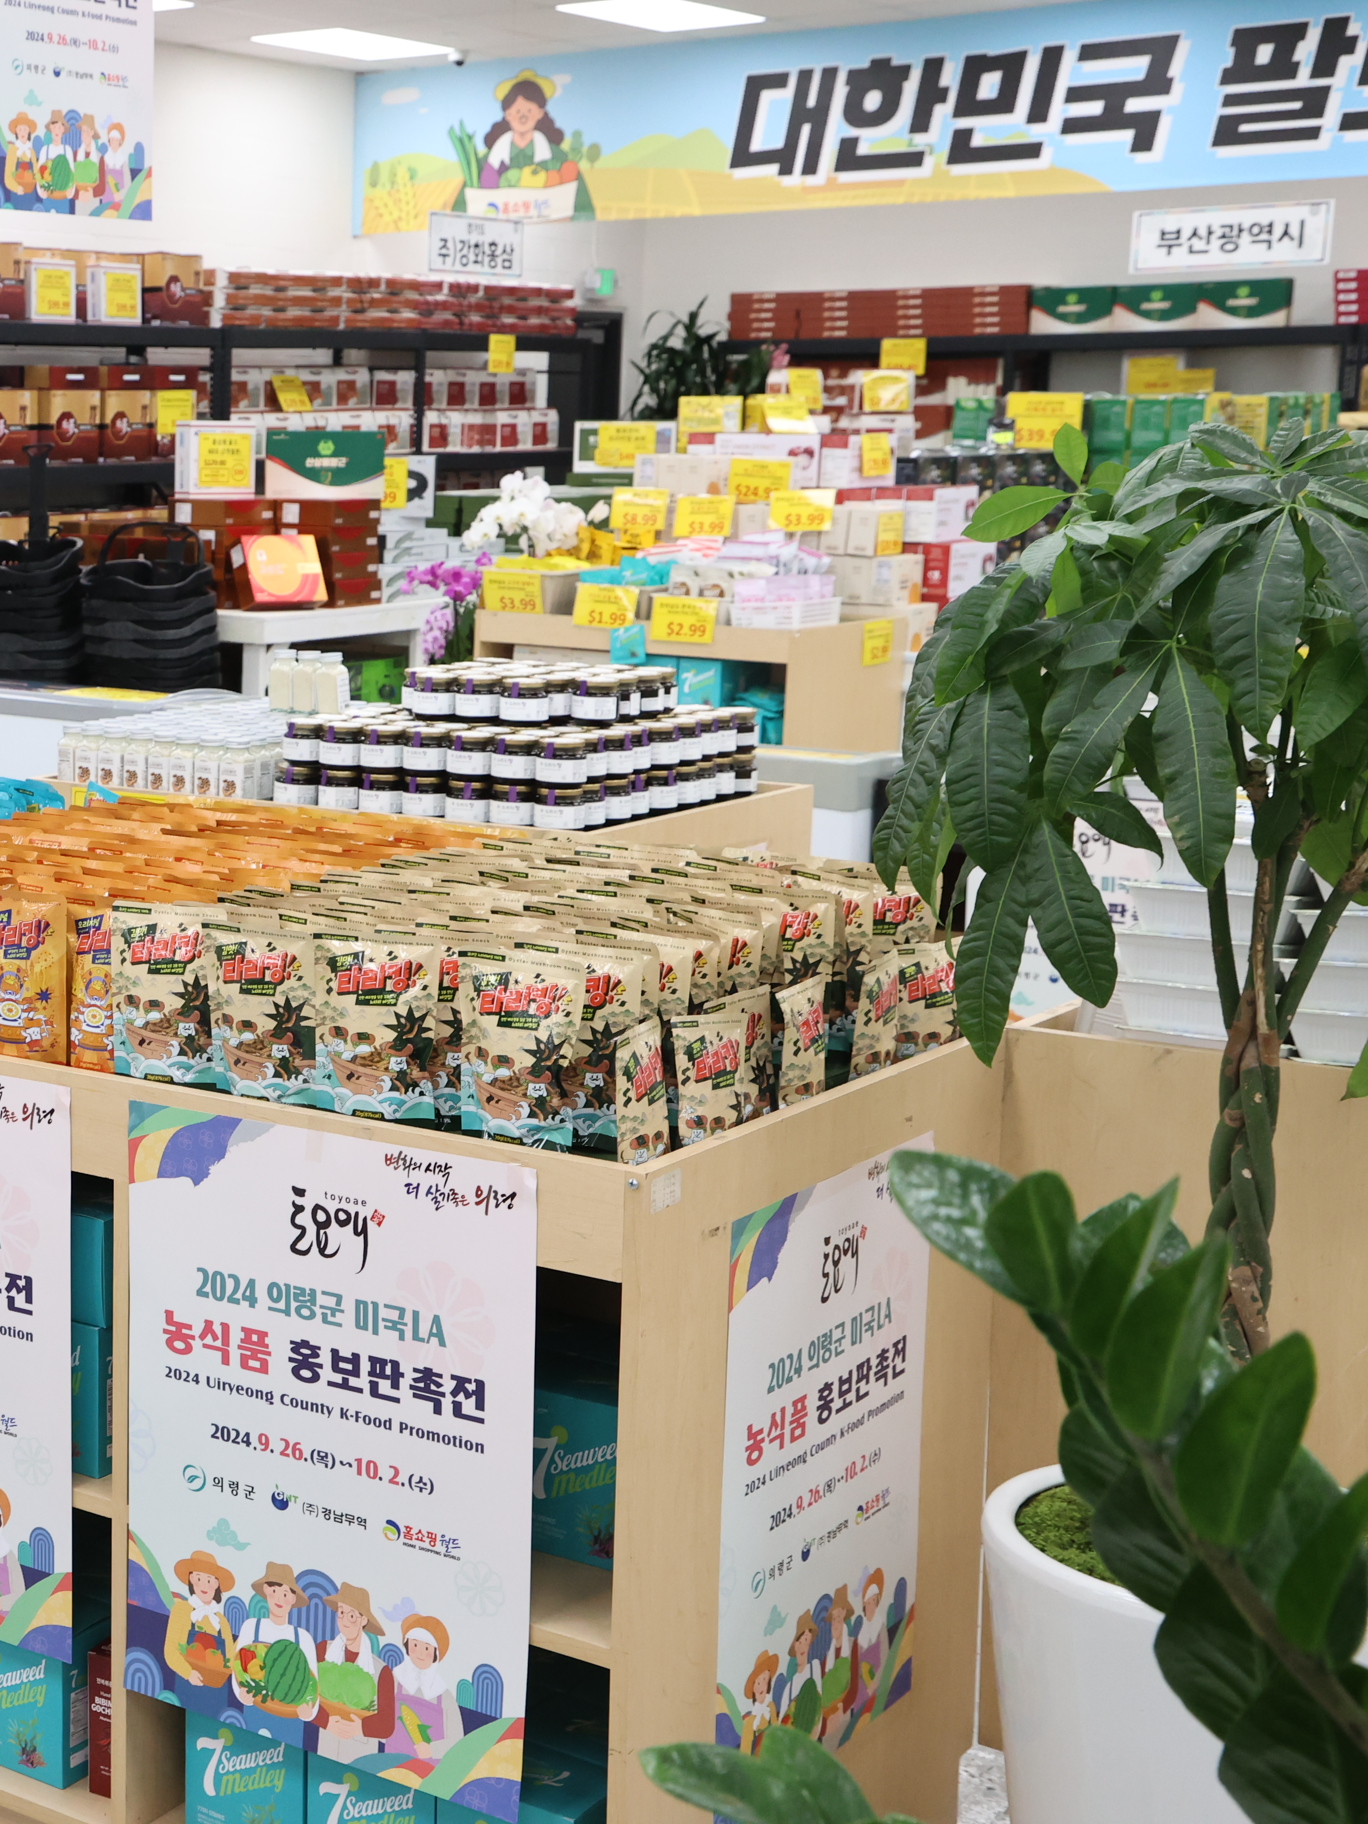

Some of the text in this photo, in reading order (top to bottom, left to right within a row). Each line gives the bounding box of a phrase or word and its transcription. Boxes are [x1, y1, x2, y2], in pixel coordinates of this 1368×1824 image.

[105, 14, 138, 27] Promotion
[728, 32, 1182, 177] 대한민국
[1156, 219, 1306, 256] 부산광역시
[622, 512, 657, 527] $8.99
[688, 520, 724, 535] $3.99
[785, 513, 825, 527] $3.99
[500, 596, 537, 611] $3.99
[588, 609, 626, 626] $1.99
[666, 622, 707, 638] $2.99
[77, 916, 100, 929] 오리지널
[21, 1103, 56, 1131] 의령
[424, 1163, 454, 1185] 시작
[324, 1190, 369, 1208] toyoae
[474, 1185, 518, 1216] 의령
[195, 1267, 448, 1348] 2024 의령군 미국LA
[162, 1309, 487, 1425] 농식품 홍보판촉전
[767, 1347, 803, 1395] 2024
[807, 1320, 846, 1372] 의령군
[164, 1365, 486, 1456] 2024 Uiryeong County K-Food Promotion
[745, 1334, 907, 1467] 농식품 홍보판촉전
[744, 1390, 905, 1497] 2024 Uiryeong County K-Food Promotion
[533, 1436, 618, 1500] 7 Seawee
[321, 1506, 368, 1530] 경남무역
[196, 1737, 285, 1797] 7 Seaweed
[343, 1789, 415, 1822] Seaweed
